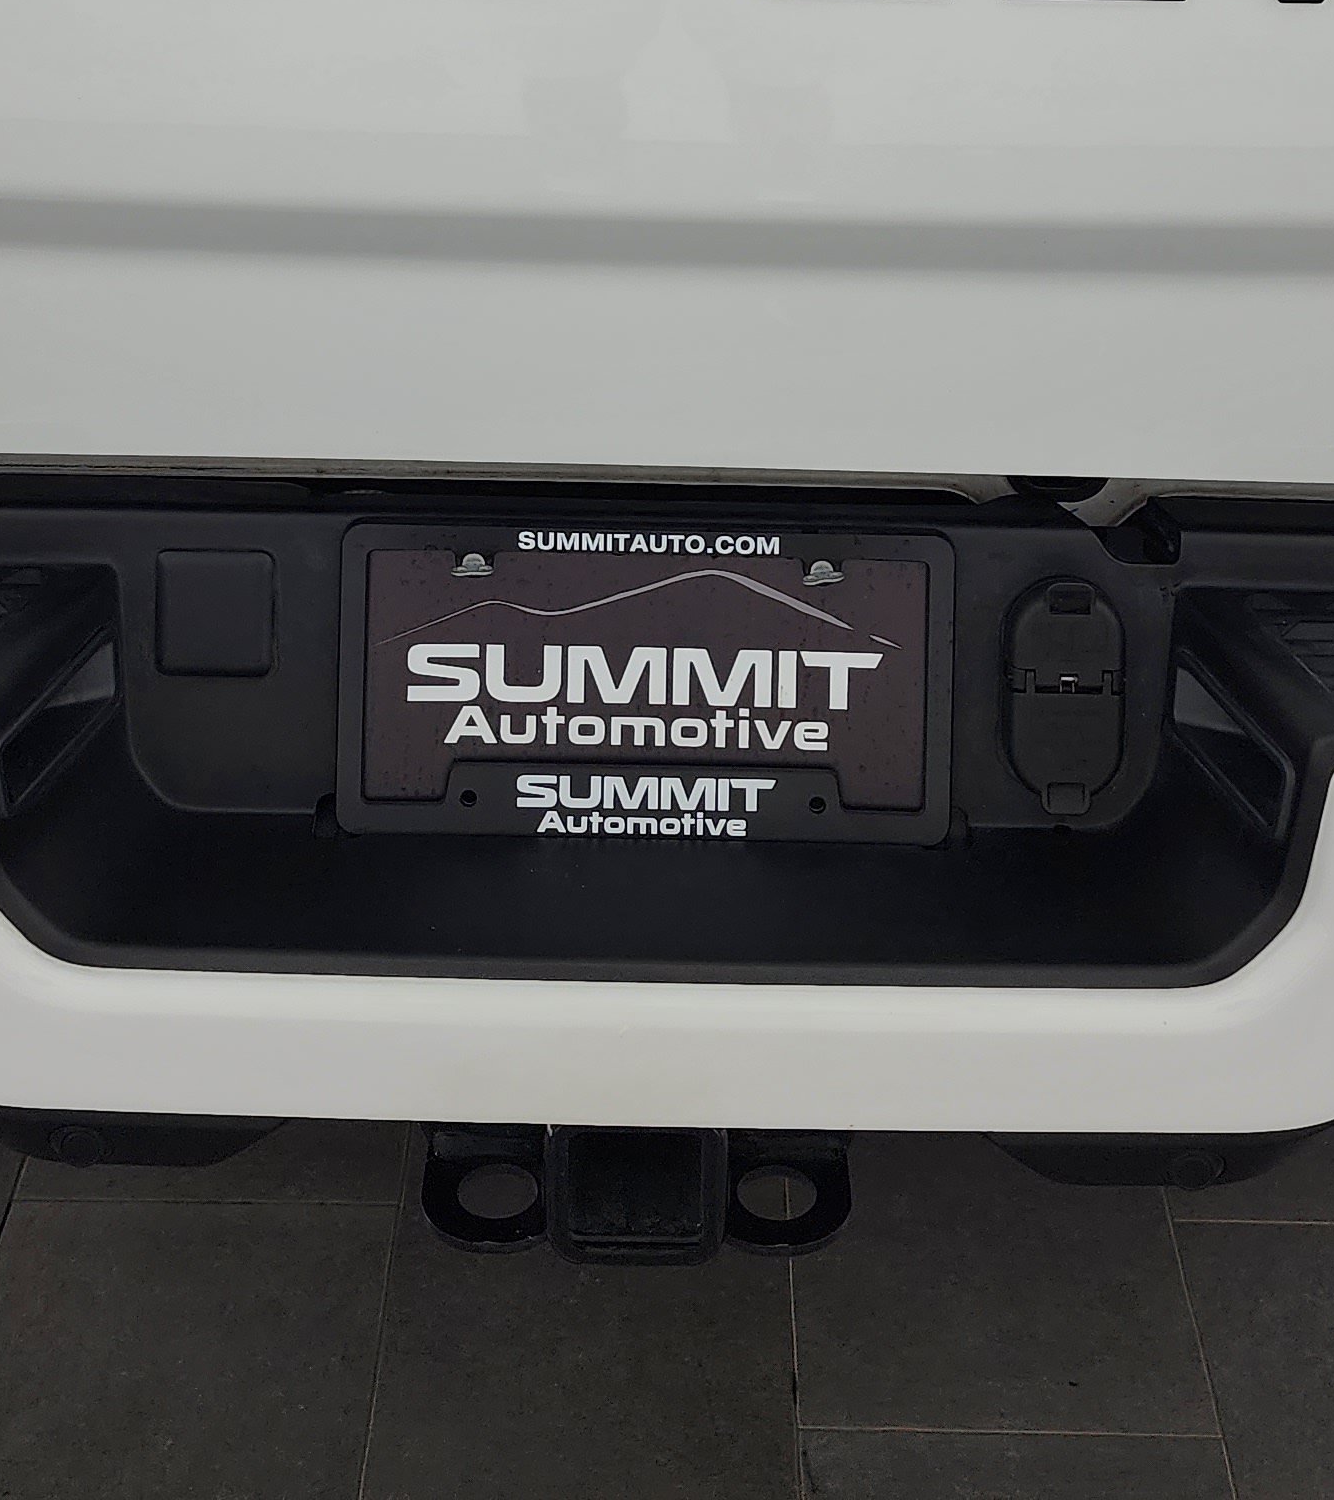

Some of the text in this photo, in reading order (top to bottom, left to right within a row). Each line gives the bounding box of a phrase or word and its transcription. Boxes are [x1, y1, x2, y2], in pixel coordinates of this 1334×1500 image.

[517, 531, 780, 555] SUMMITAUTO.COM
[406, 643, 884, 710] SUMMIT
[444, 705, 829, 751] Automotive
[516, 775, 776, 812] SUMMIT
[536, 811, 747, 837] Automotive
